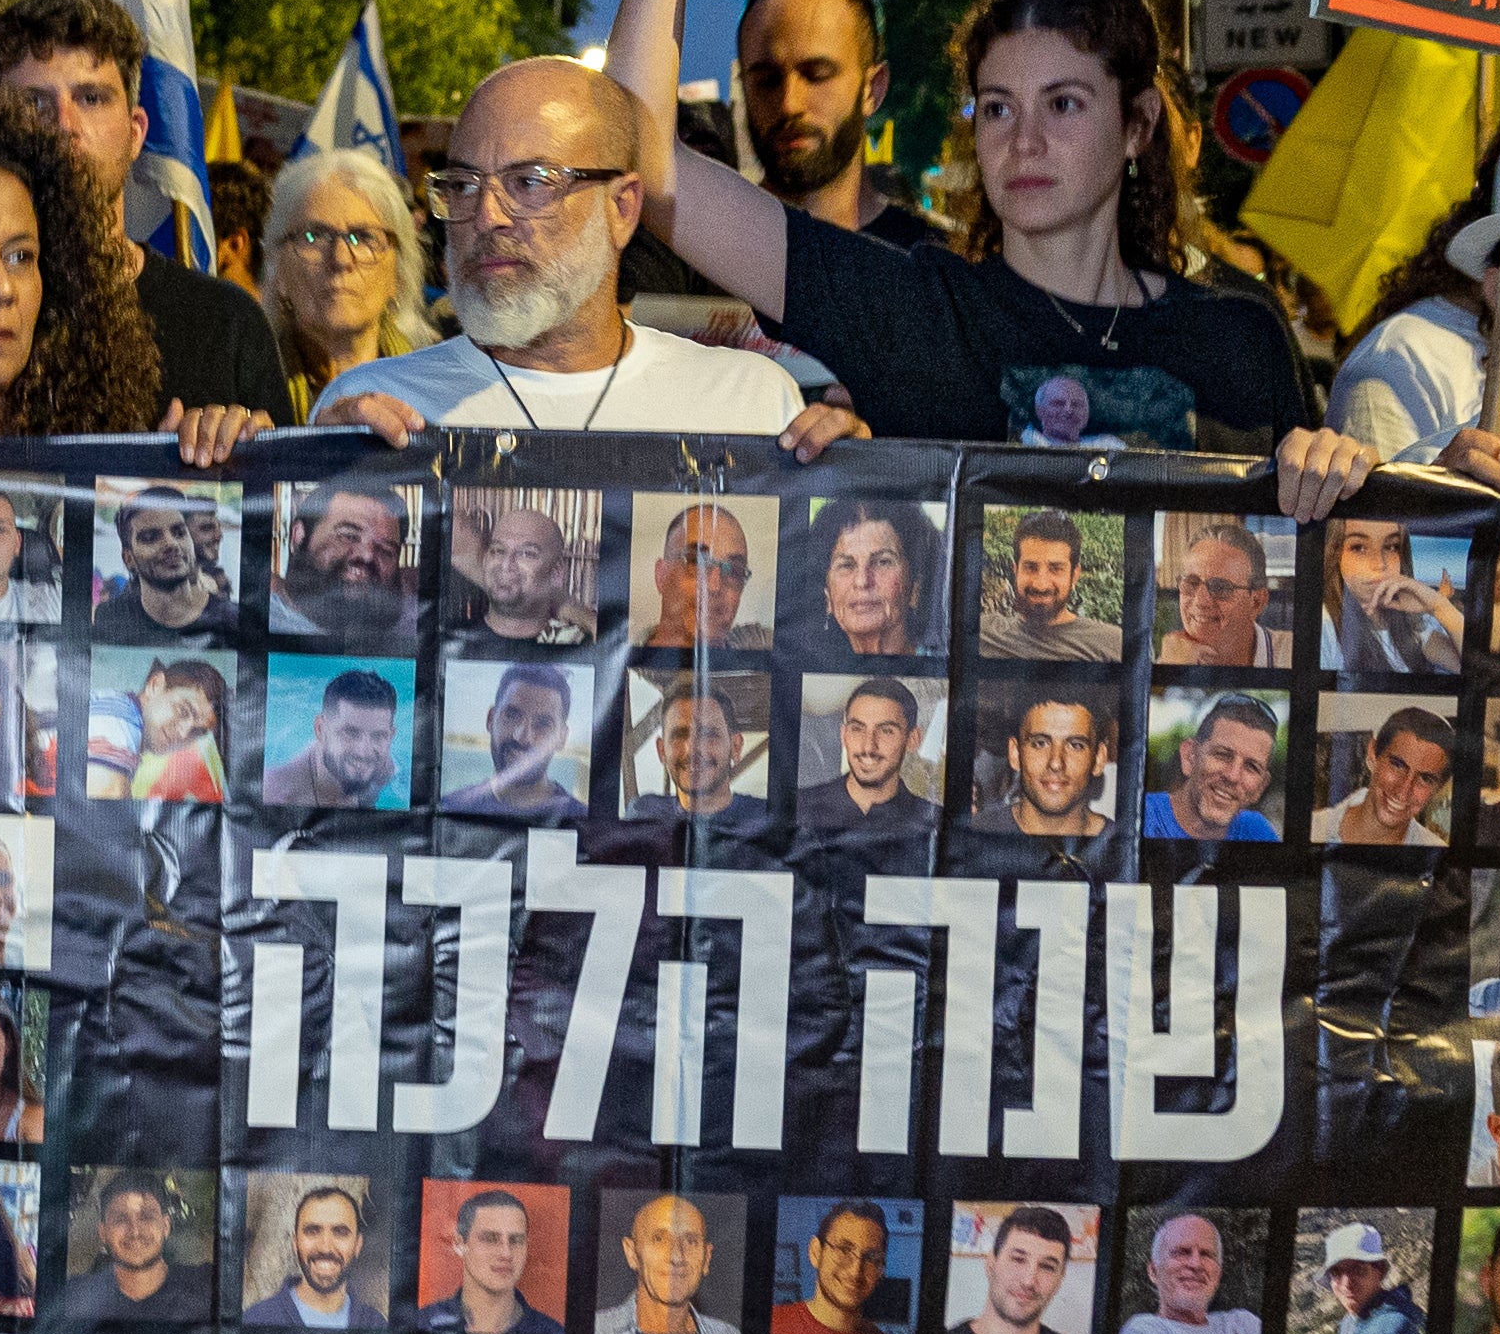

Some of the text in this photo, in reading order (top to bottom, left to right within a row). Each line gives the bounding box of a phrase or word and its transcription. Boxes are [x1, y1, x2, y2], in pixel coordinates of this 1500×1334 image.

[1226, 27, 1302, 49] NEW
[246, 827, 1288, 1163] שנה הלכה
